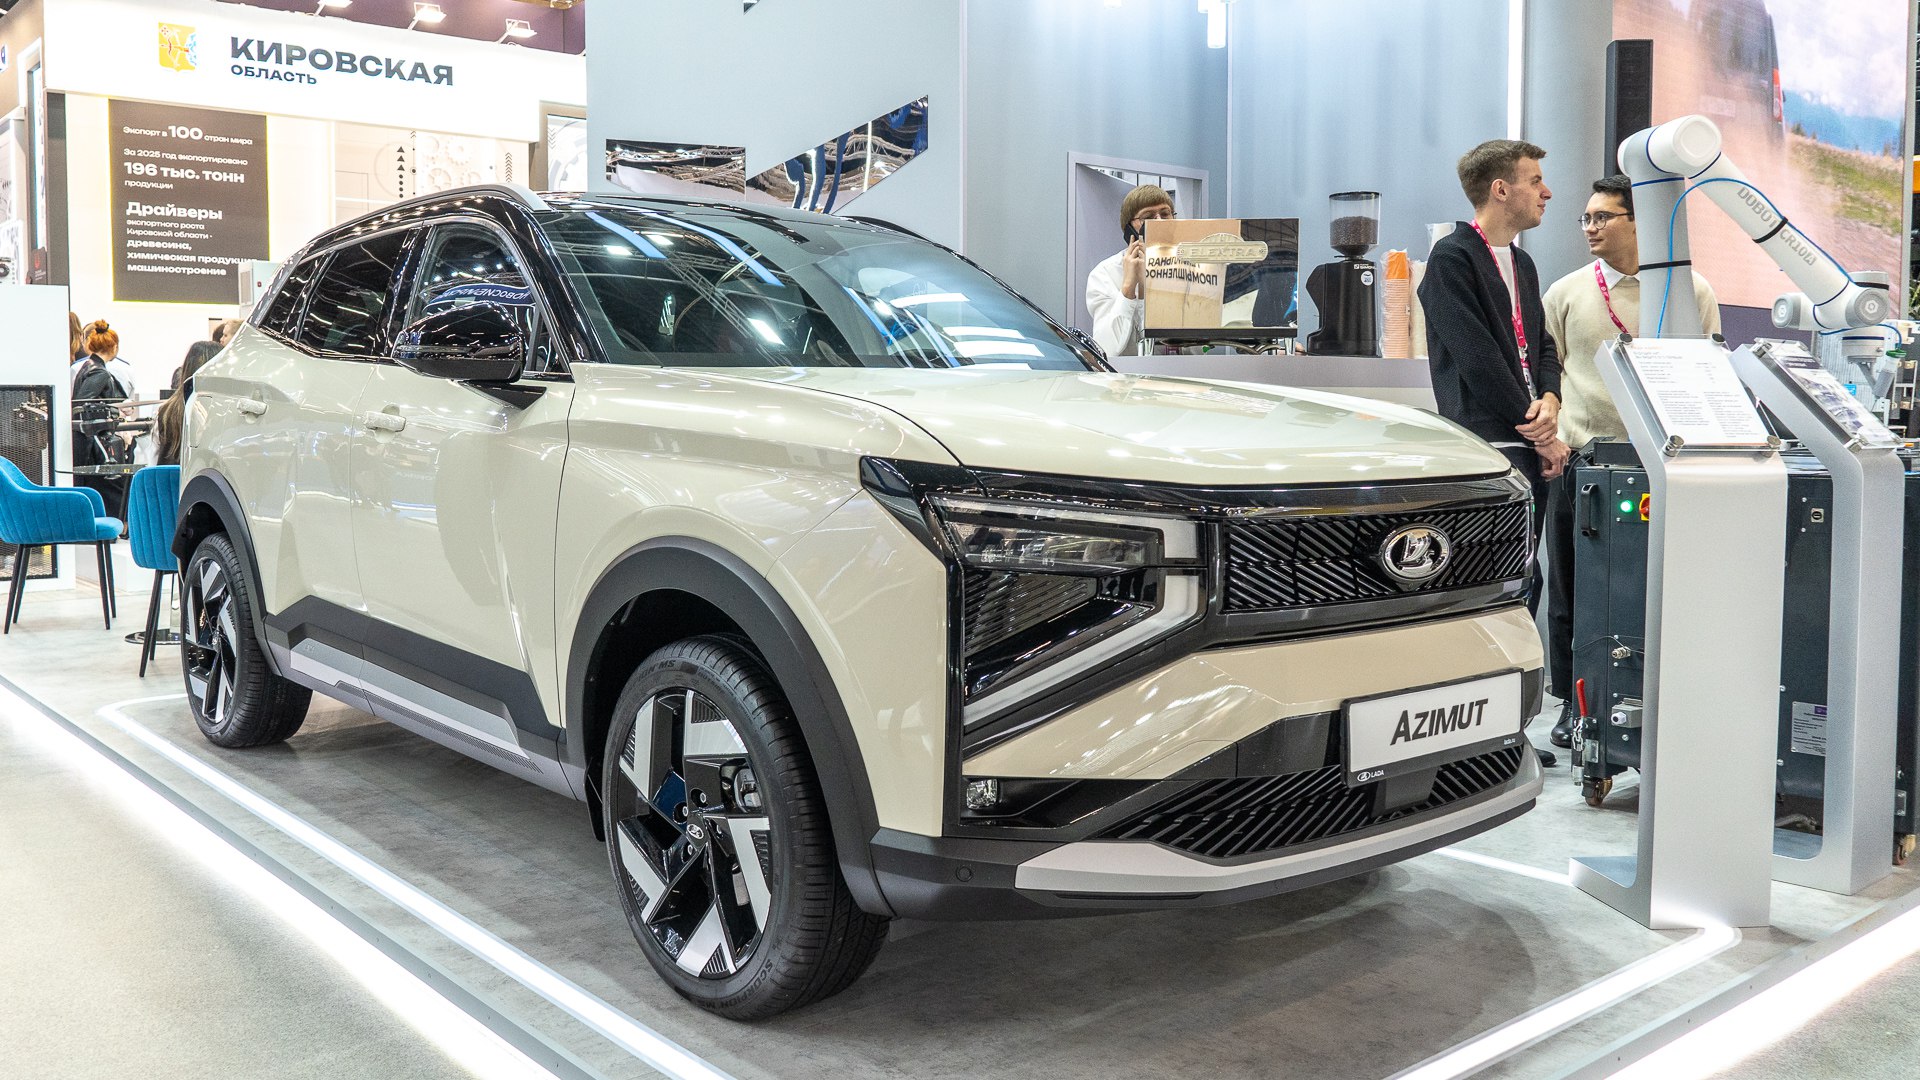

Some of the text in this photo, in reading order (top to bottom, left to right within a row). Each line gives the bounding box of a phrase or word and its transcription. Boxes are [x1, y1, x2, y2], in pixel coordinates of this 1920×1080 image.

[230, 36, 453, 86] КИРОВСКАЯ
[230, 64, 317, 85] ОБЛАСТЬ
[123, 126, 161, 137] Экспорт
[168, 125, 203, 140] 100
[204, 134, 229, 143] стран
[123, 148, 248, 166] За 2025 год экспортировано
[123, 162, 245, 183] 196 тыс. тонн
[124, 180, 174, 190] продукции
[126, 201, 223, 220] Драйверы
[1737, 186, 1779, 228] DOBOT
[126, 219, 205, 230] экспортного роста
[126, 228, 173, 237] Кировской
[174, 231, 209, 239] области
[126, 239, 193, 251] древесина,
[1191, 247, 1256, 258] ELEKTRA
[126, 251, 257, 265] химическая продукц
[127, 263, 227, 276] машиностроение
[1389, 698, 1489, 746] AZIMUT
[1370, 769, 1385, 778] LADA
[721, 958, 773, 1009] SCORPION
